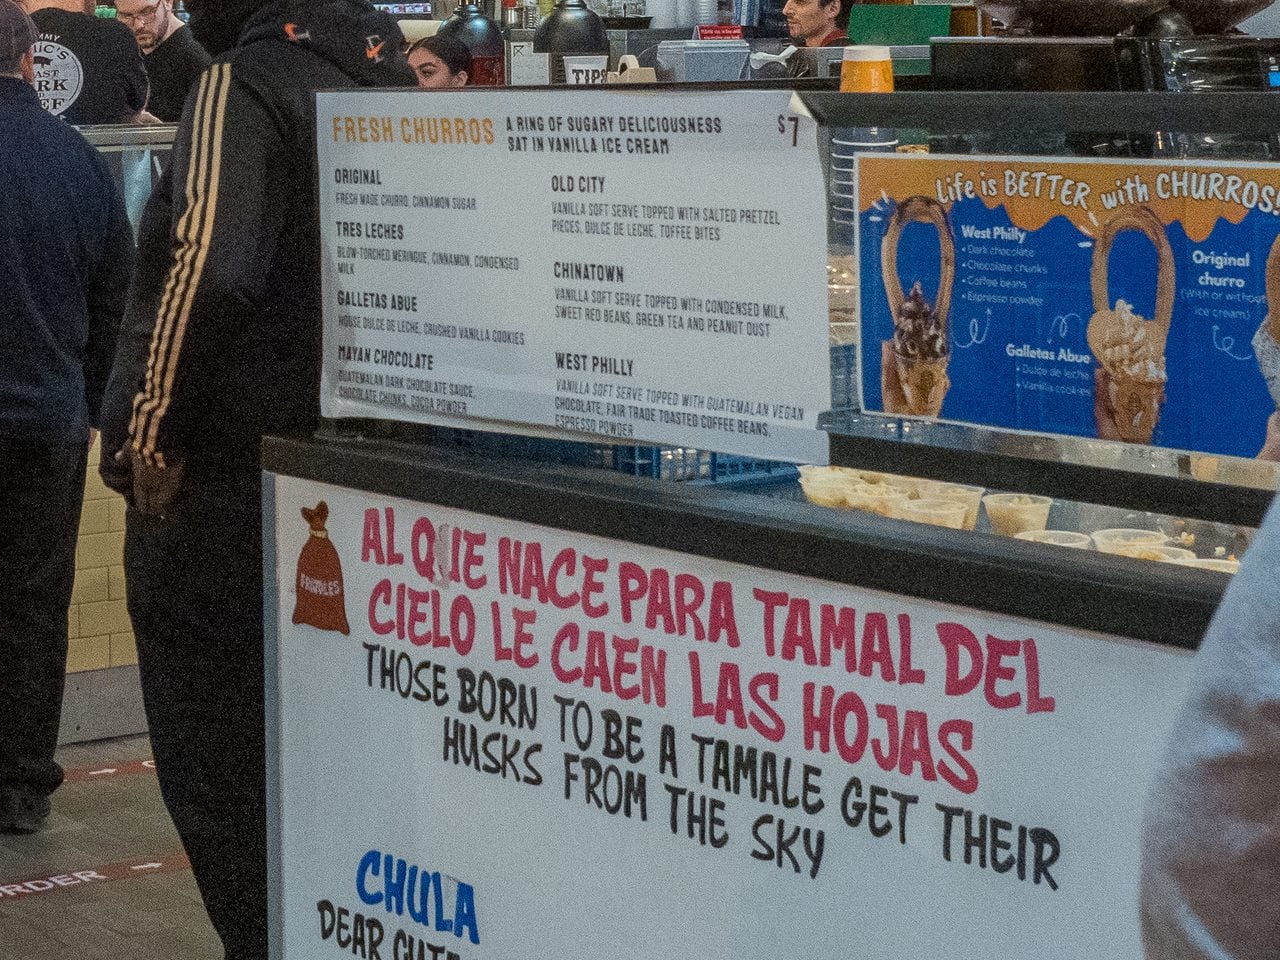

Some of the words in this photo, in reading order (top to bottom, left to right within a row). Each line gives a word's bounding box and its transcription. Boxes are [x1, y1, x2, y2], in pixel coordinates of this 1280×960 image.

[331, 116, 393, 144] FRESH
[401, 116, 495, 145] CHURROS
[506, 117, 513, 131] A
[517, 117, 544, 131] RING
[549, 116, 562, 132] OF
[568, 116, 613, 133] SUGARY
[620, 116, 721, 134] DELICIOUSNESS
[777, 114, 799, 147] $7
[508, 137, 528, 152] SAT
[532, 137, 544, 152] IN
[549, 138, 597, 153] VANILLA
[602, 138, 621, 153] ICE
[626, 138, 669, 154] CREAM
[335, 169, 382, 185] ORIGINAL
[551, 176, 575, 192] OLD
[578, 176, 605, 193] CITY
[936, 172, 975, 204] Life
[980, 171, 998, 196] is
[1004, 169, 1090, 210] BETTER
[1101, 175, 1149, 209] with
[336, 221, 362, 238] TRES
[365, 222, 404, 240] LECHES
[961, 225, 991, 240] West
[994, 226, 1027, 244] Philly
[554, 262, 624, 283] CHINATOWN
[1193, 251, 1250, 269] Original
[1199, 272, 1245, 287] churro
[337, 291, 387, 309] GALLETAS
[391, 293, 417, 312] ABUE
[554, 288, 589, 302] VANILLA
[591, 290, 612, 304] SOFT
[614, 291, 641, 307] SERVE
[644, 294, 677, 310] TOPPED
[680, 297, 702, 313] WITH
[704, 299, 759, 317] CONDENSED
[554, 305, 583, 320] SWEET
[584, 307, 601, 322] RED
[636, 312, 664, 327] GREEN
[667, 314, 684, 329] TEA
[687, 316, 705, 331] AND
[707, 318, 743, 335] PEANUT
[746, 321, 770, 338] DUST
[338, 346, 371, 362] MAYAN
[374, 348, 434, 371] CHOCOLATE
[555, 352, 587, 370] WEST
[592, 356, 634, 377] PHILLY
[1006, 343, 1054, 363] Galletas
[1057, 348, 1090, 365] Abue
[361, 506, 404, 566] AL
[499, 537, 610, 619] NACE
[618, 561, 740, 647] PARA
[752, 587, 926, 685] TAMAL
[935, 622, 1056, 715] DEL
[368, 579, 476, 657] CIELO
[492, 601, 539, 669] LE
[551, 622, 667, 708] CAEN
[688, 651, 786, 742] LAS
[803, 681, 978, 794] HOJAS
[362, 642, 449, 707] THOSE
[458, 667, 538, 731] BORN
[554, 695, 593, 752] TO
[600, 709, 644, 763] BE
[660, 724, 678, 779] A
[691, 732, 825, 815] TAMALE
[840, 777, 919, 845] GET
[935, 803, 1060, 892] THEIR
[443, 717, 544, 786] HUSKS
[563, 753, 648, 821] FROM
[664, 784, 729, 848] THE
[751, 814, 825, 880] SKY
[355, 850, 481, 944] CHULA
[317, 899, 385, 960] DEAR
